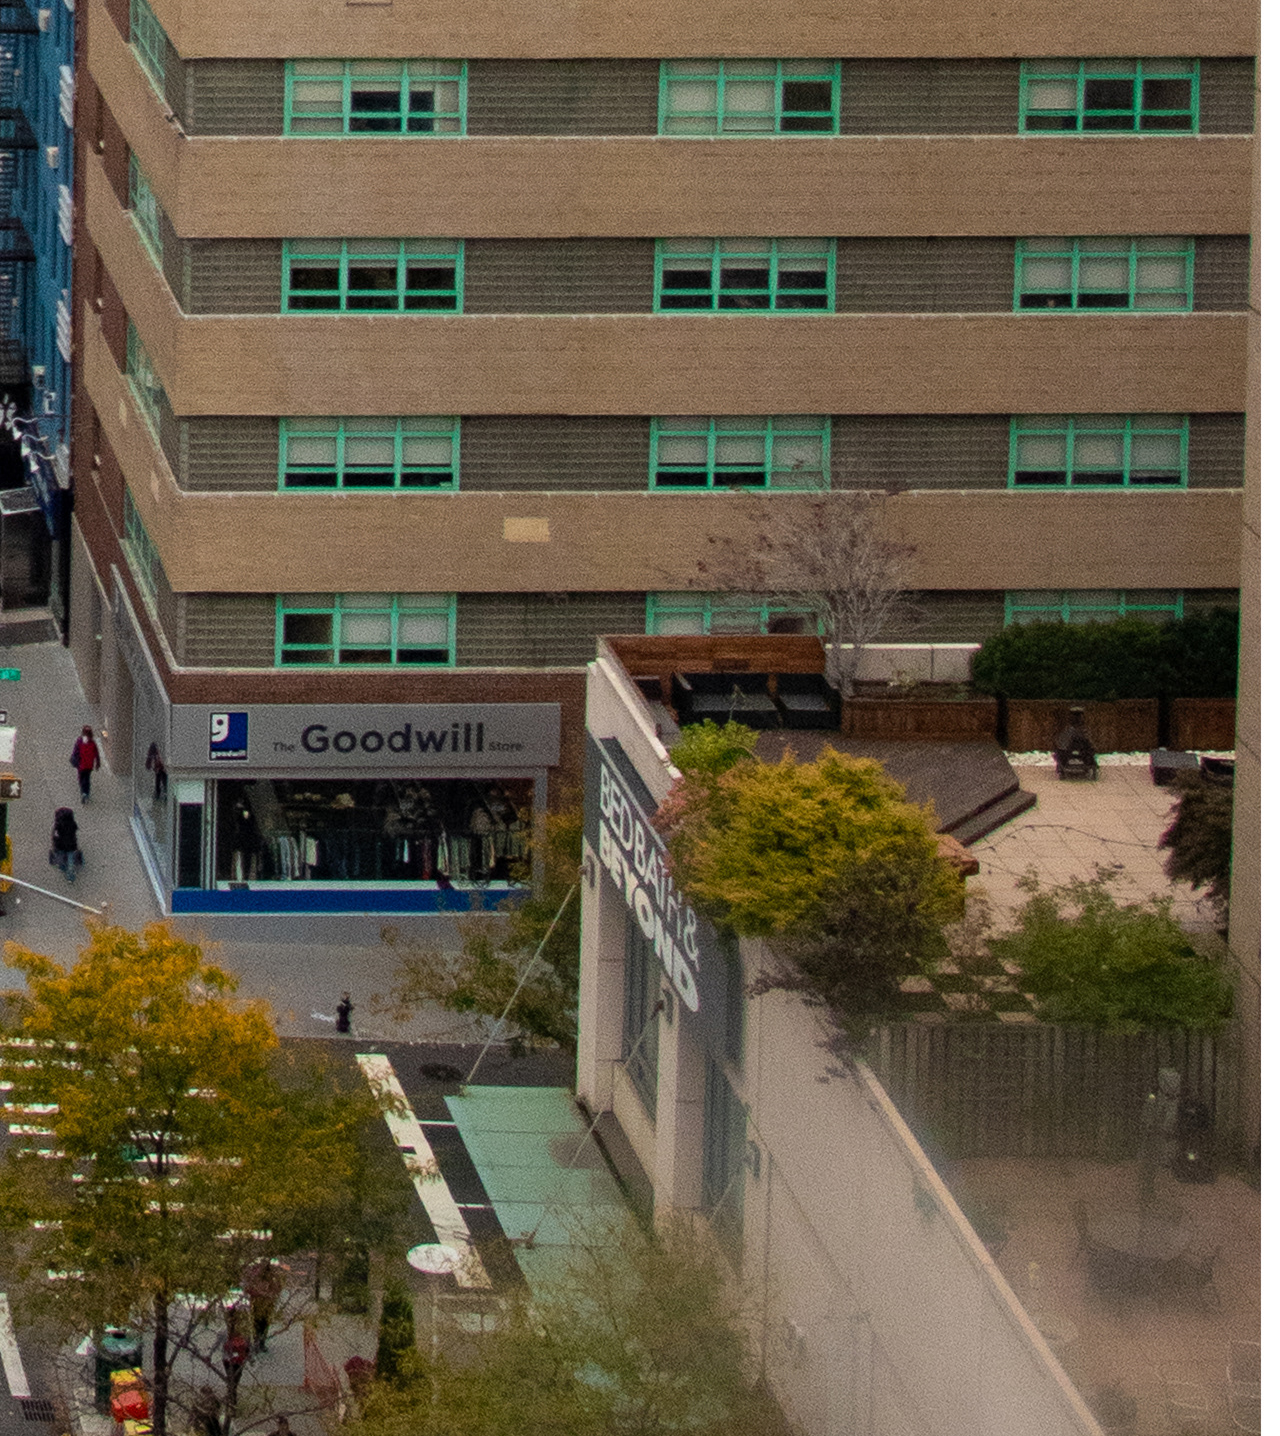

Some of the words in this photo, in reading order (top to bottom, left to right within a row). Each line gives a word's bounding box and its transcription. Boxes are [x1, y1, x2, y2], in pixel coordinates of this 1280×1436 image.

[272, 741, 295, 753] The
[300, 723, 485, 754] Goodwill
[490, 741, 525, 753] Store
[600, 763, 633, 852] BED
[599, 818, 700, 1012] BEYOND
